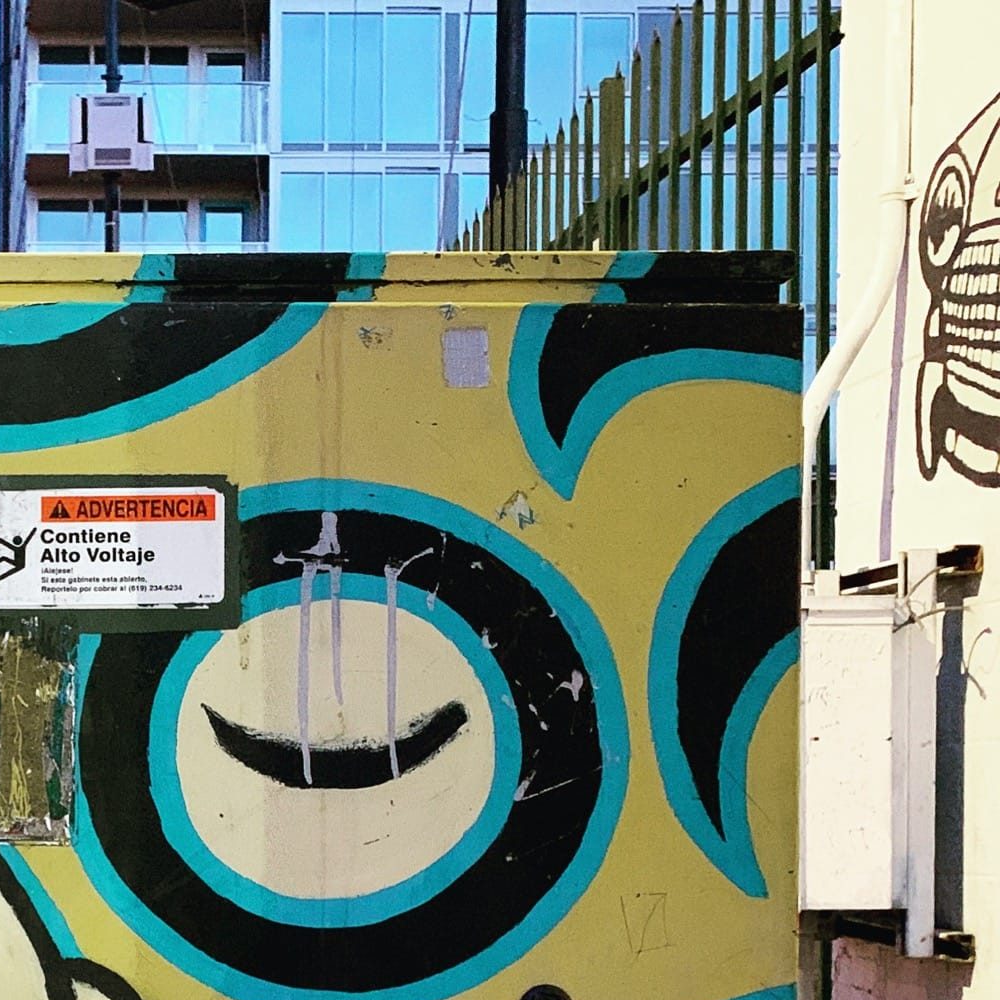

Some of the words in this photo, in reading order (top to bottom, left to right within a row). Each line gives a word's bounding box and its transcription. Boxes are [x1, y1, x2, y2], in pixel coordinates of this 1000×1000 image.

[76, 499, 208, 518] ADVERTENCIA
[40, 529, 131, 544] Contiene
[40, 548, 81, 563] Alto
[86, 547, 156, 566] Voltaje
[79, 586, 91, 594] por
[128, 585, 147, 593] (619)
[149, 584, 183, 592] 234-6234
